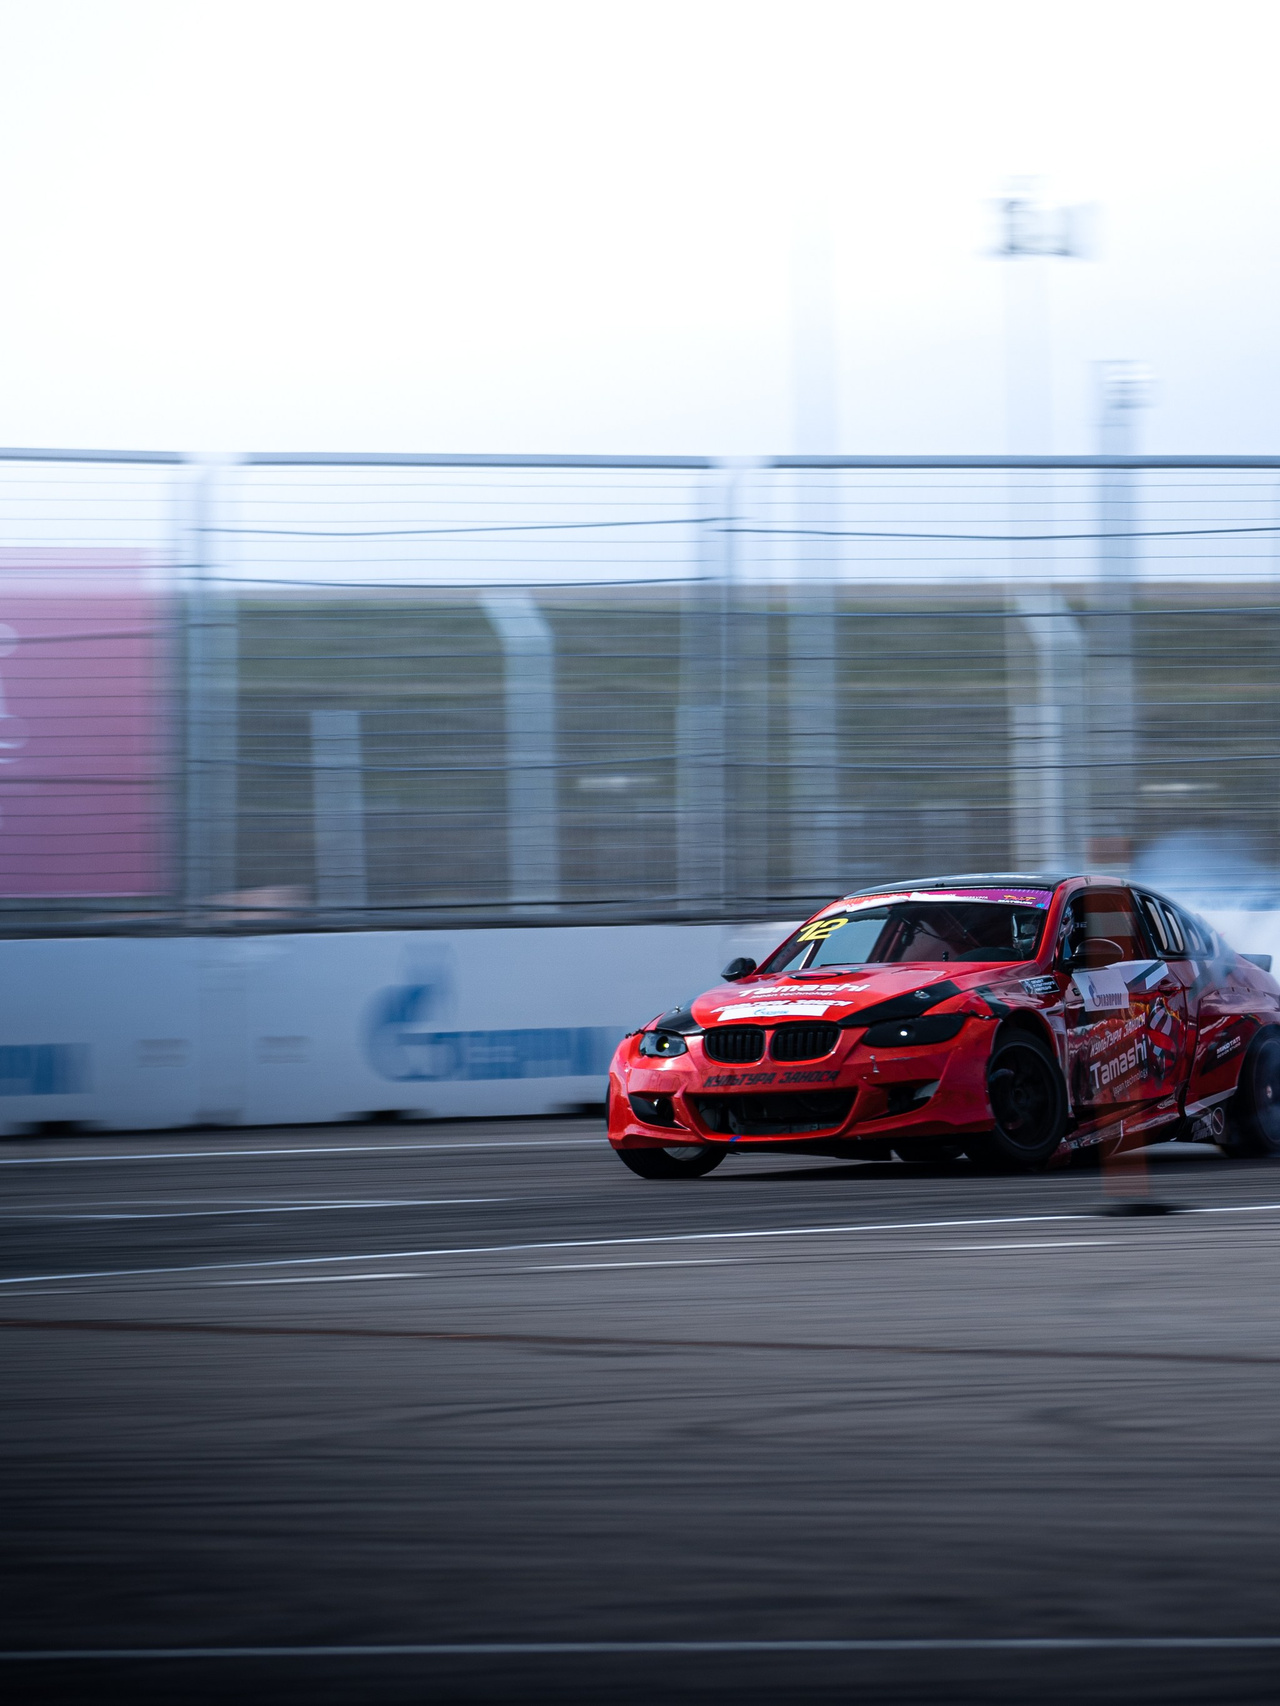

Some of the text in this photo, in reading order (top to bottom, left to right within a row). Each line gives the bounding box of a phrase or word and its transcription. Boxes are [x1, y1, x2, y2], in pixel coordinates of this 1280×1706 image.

[797, 918, 849, 942] 12
[738, 983, 871, 998] Tamashi
[1090, 1034, 1148, 1089] Tamashi
[703, 1070, 840, 1088] КУЛЬТУРА ЗАНОСА
